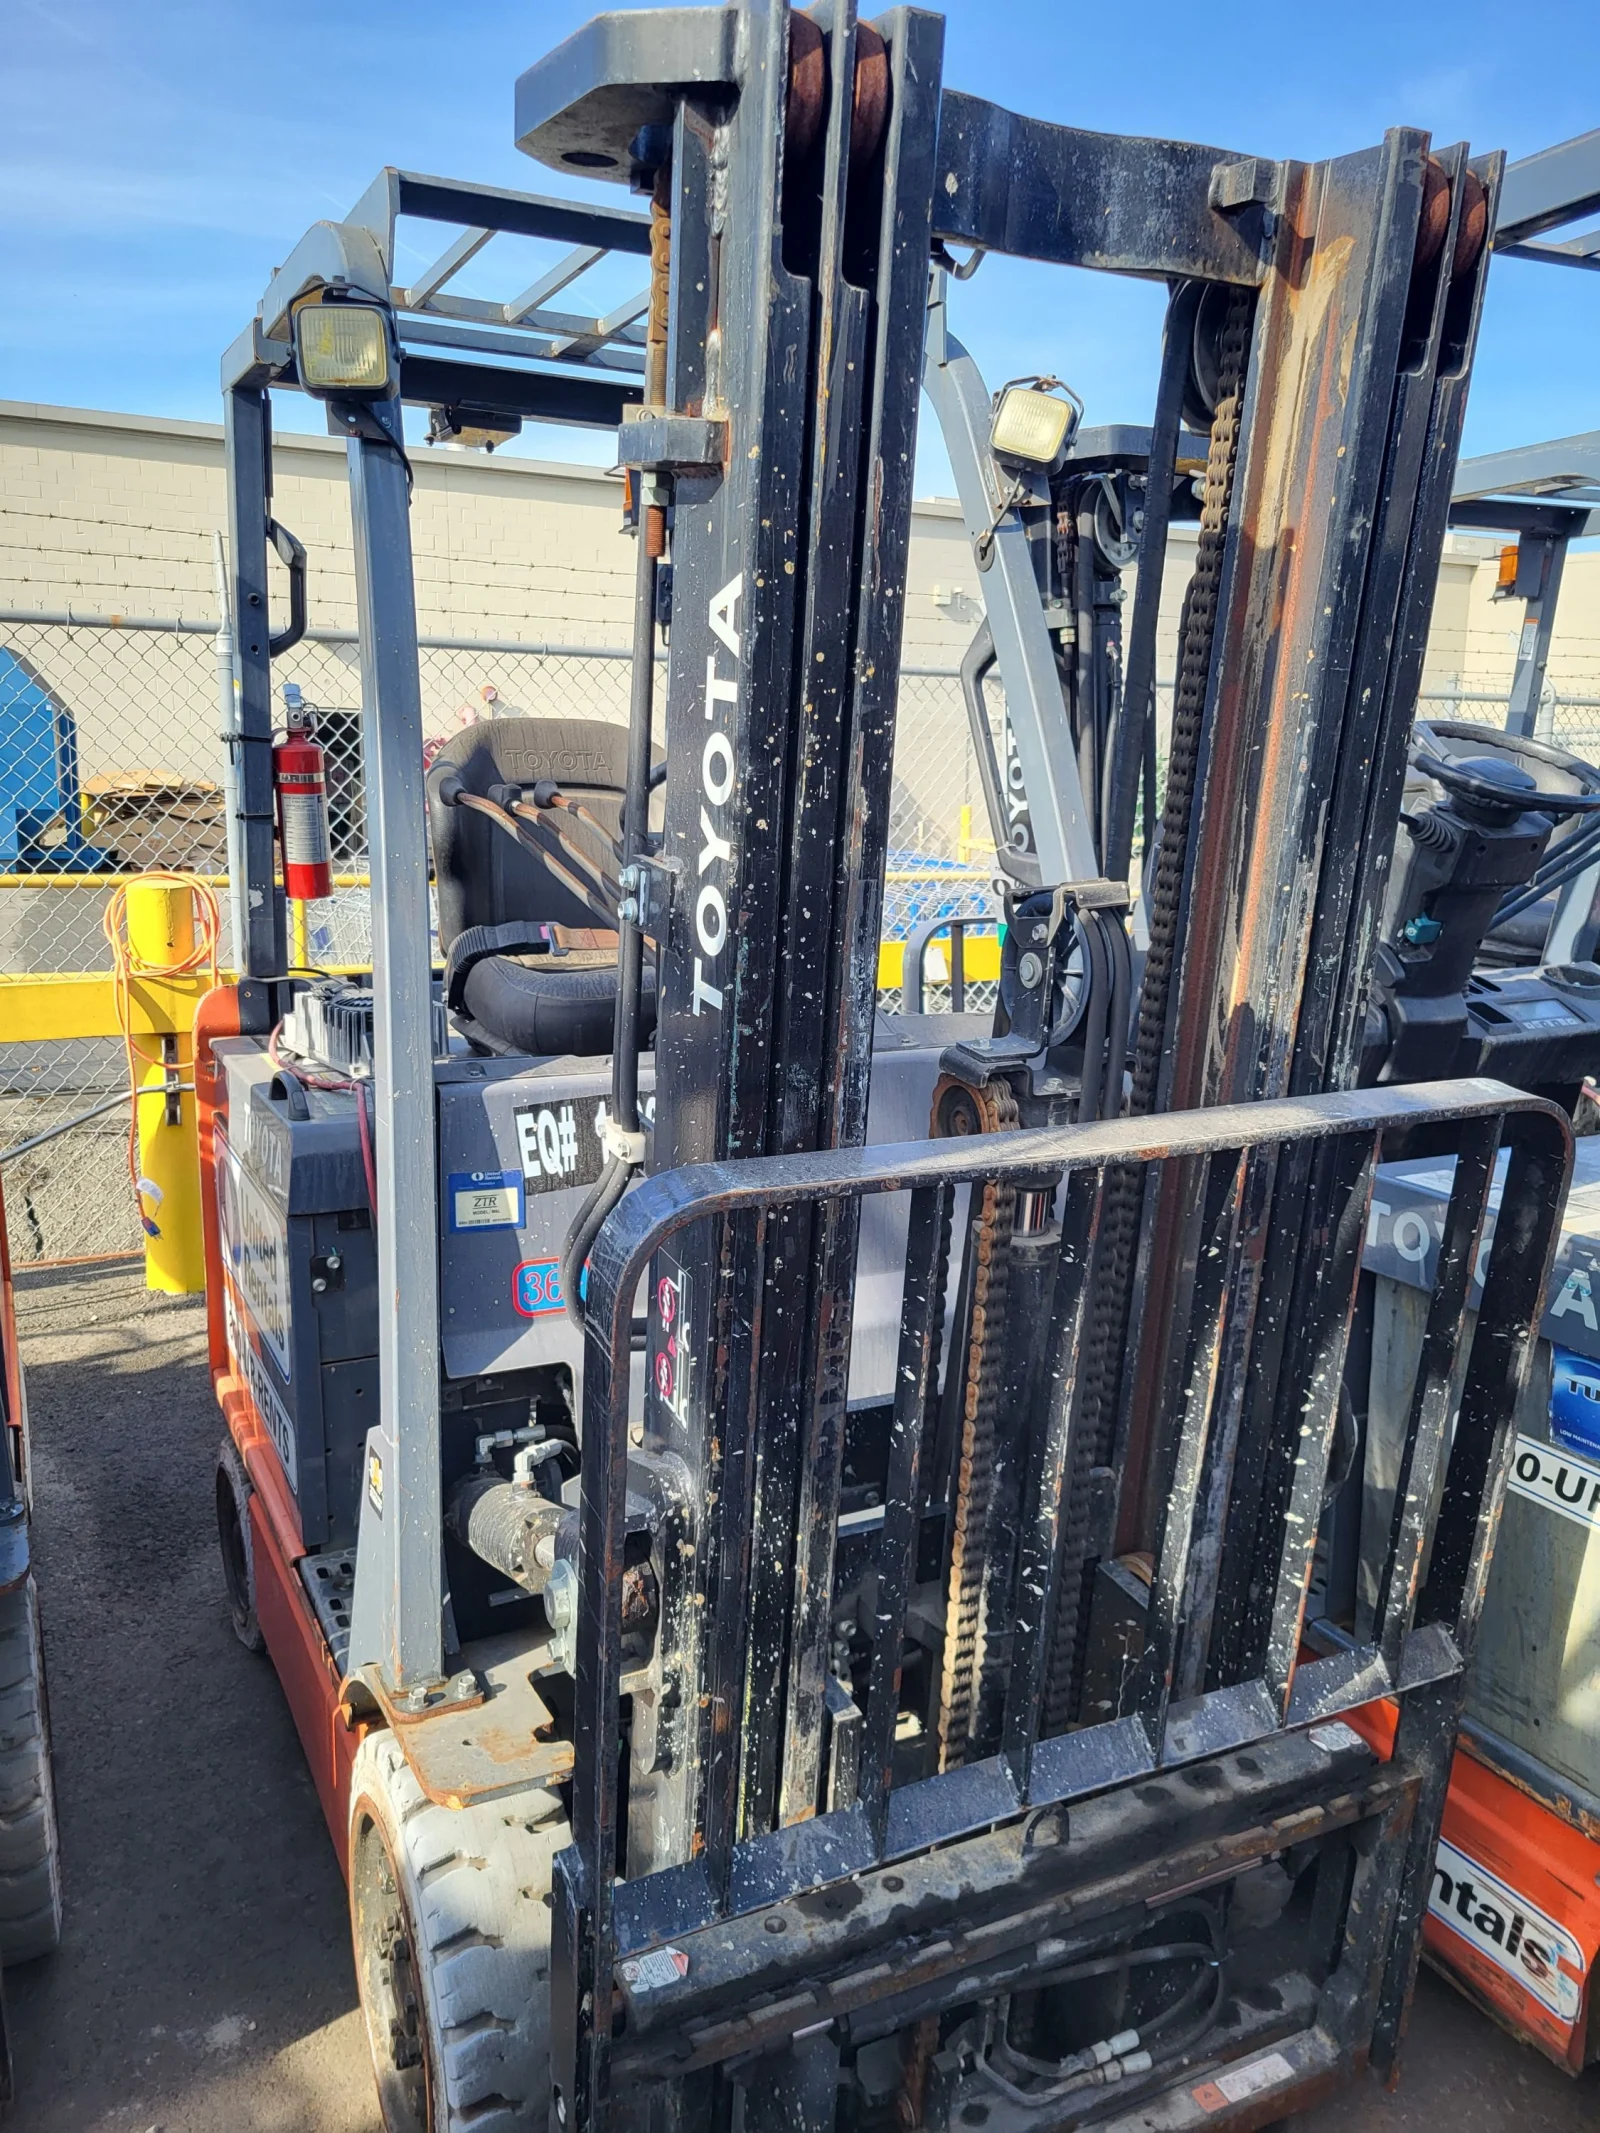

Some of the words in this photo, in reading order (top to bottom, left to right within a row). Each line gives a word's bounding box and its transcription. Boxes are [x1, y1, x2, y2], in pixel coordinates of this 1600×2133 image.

[505, 749, 612, 771] TOYOTA
[693, 572, 743, 1017] TOYOTA
[243, 1102, 282, 1185] TOYOTA
[516, 1106, 578, 1178] EQ#
[474, 1196, 497, 1207] ZTR
[1560, 1428, 1573, 1438] LOW
